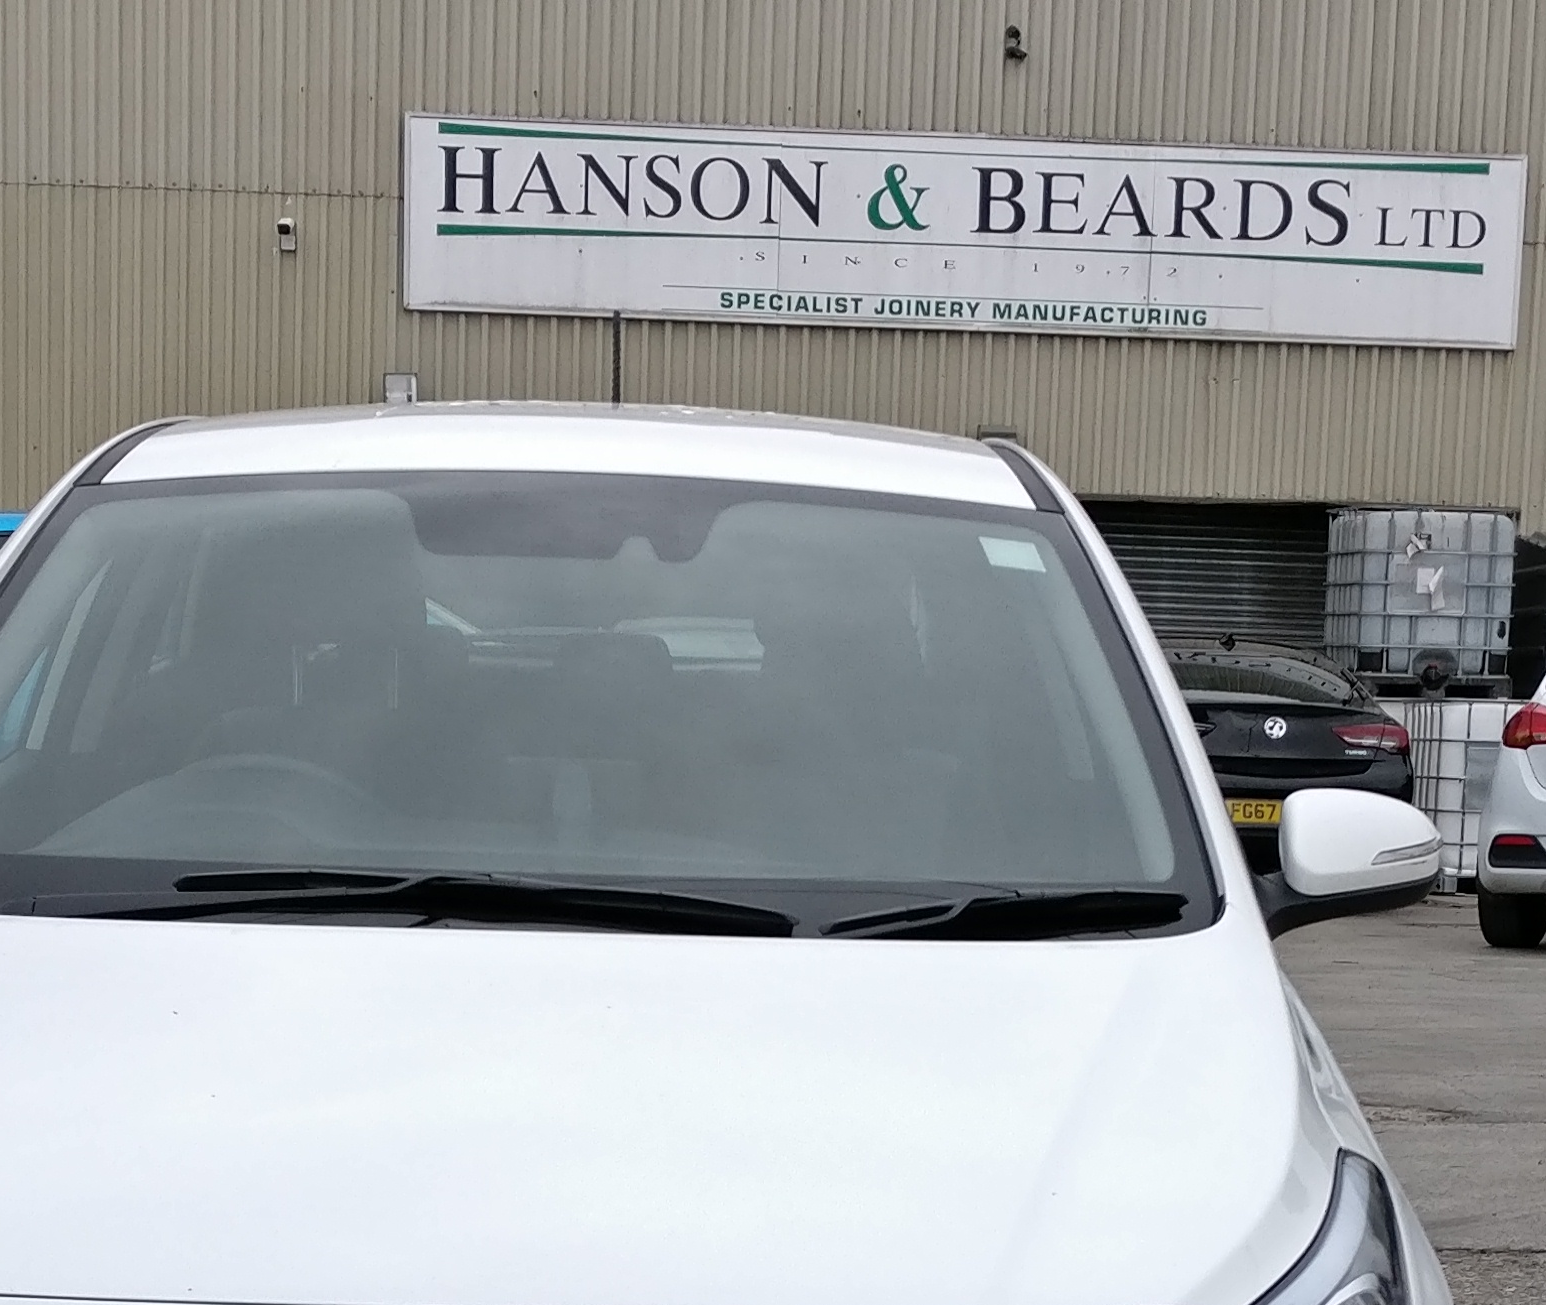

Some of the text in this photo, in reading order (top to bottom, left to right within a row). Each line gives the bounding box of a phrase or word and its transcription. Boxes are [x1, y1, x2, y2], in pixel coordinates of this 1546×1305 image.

[437, 145, 1487, 249] HANSON & BEARDS LTD
[720, 292, 1208, 327] SPECIALIST JOINERY MANUFACTURING
[1232, 803, 1277, 820] FG67
